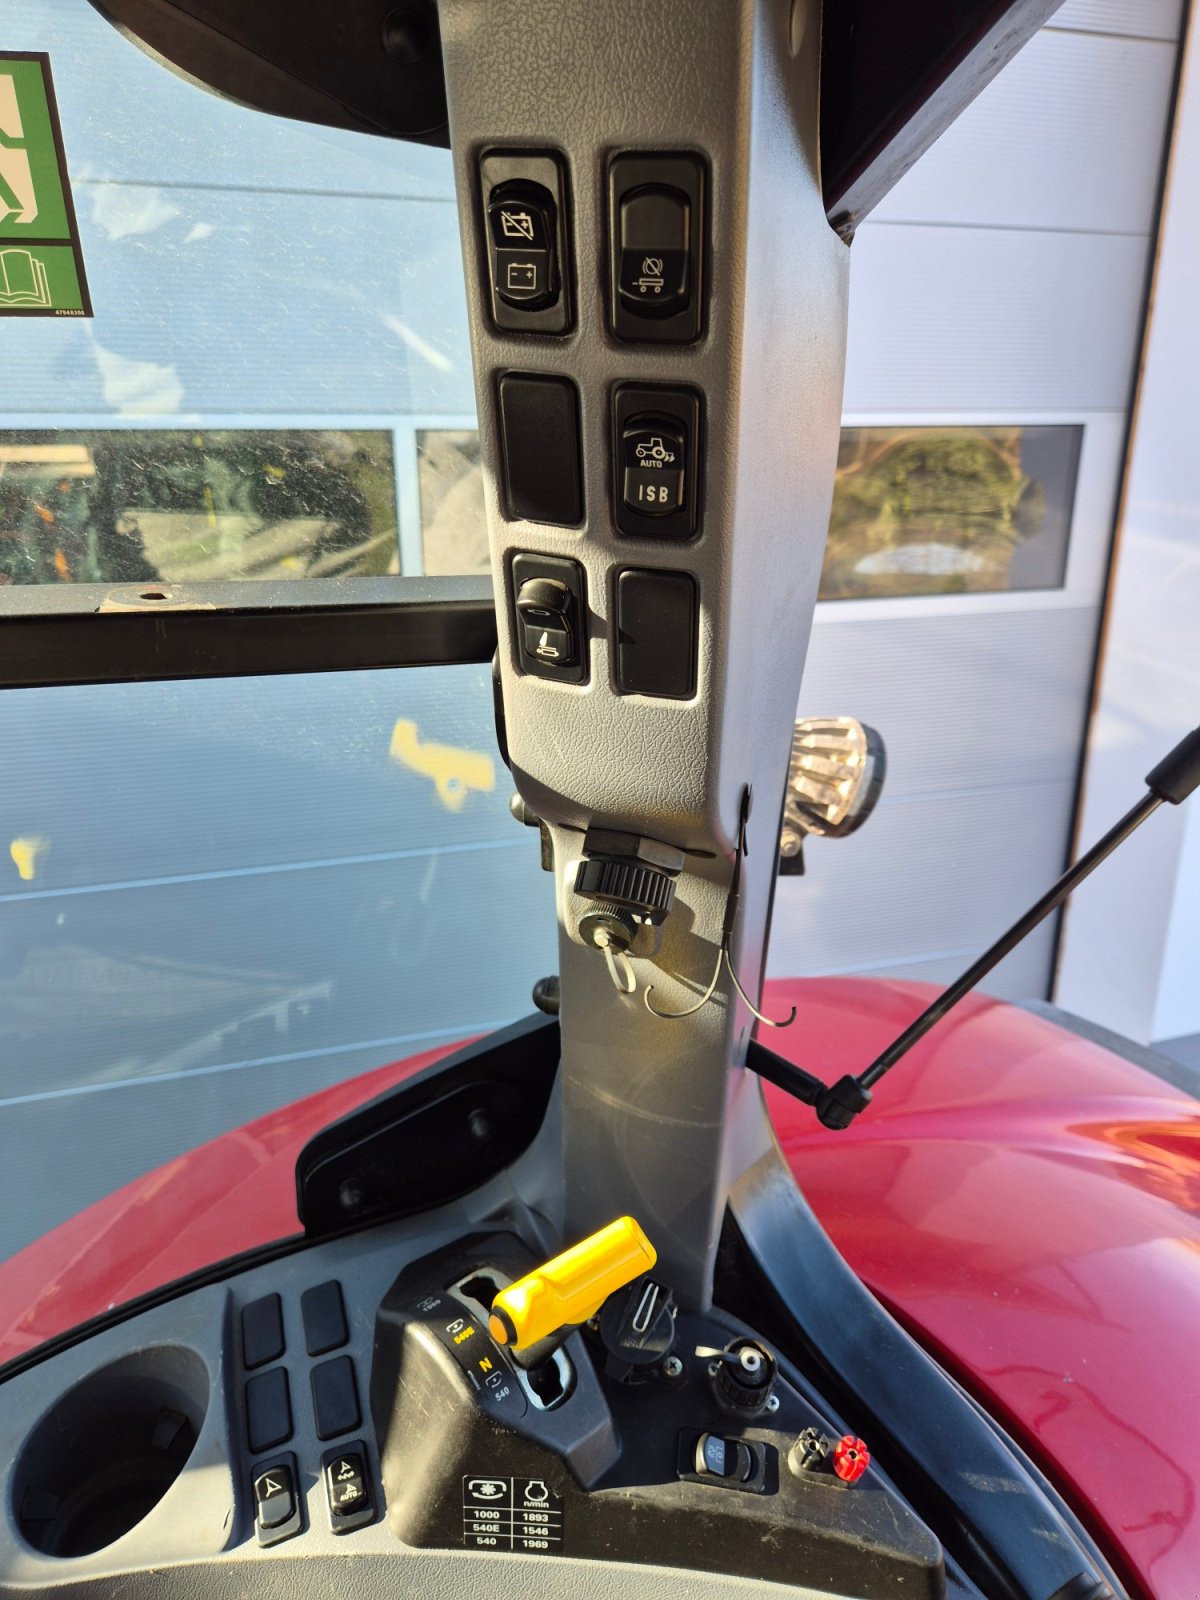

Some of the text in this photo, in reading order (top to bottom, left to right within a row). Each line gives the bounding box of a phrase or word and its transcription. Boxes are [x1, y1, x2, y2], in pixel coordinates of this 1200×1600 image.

[640, 459, 662, 468] AUTO
[479, 1357, 493, 1372] N
[495, 1387, 510, 1401] 540
[340, 1490, 357, 1501] AUTO
[474, 1510, 500, 1519] 1000
[523, 1513, 549, 1522] 1893
[473, 1524, 500, 1533] 540E
[523, 1526, 549, 1535] 1546
[477, 1537, 497, 1545] 540
[523, 1539, 549, 1548] 1969
